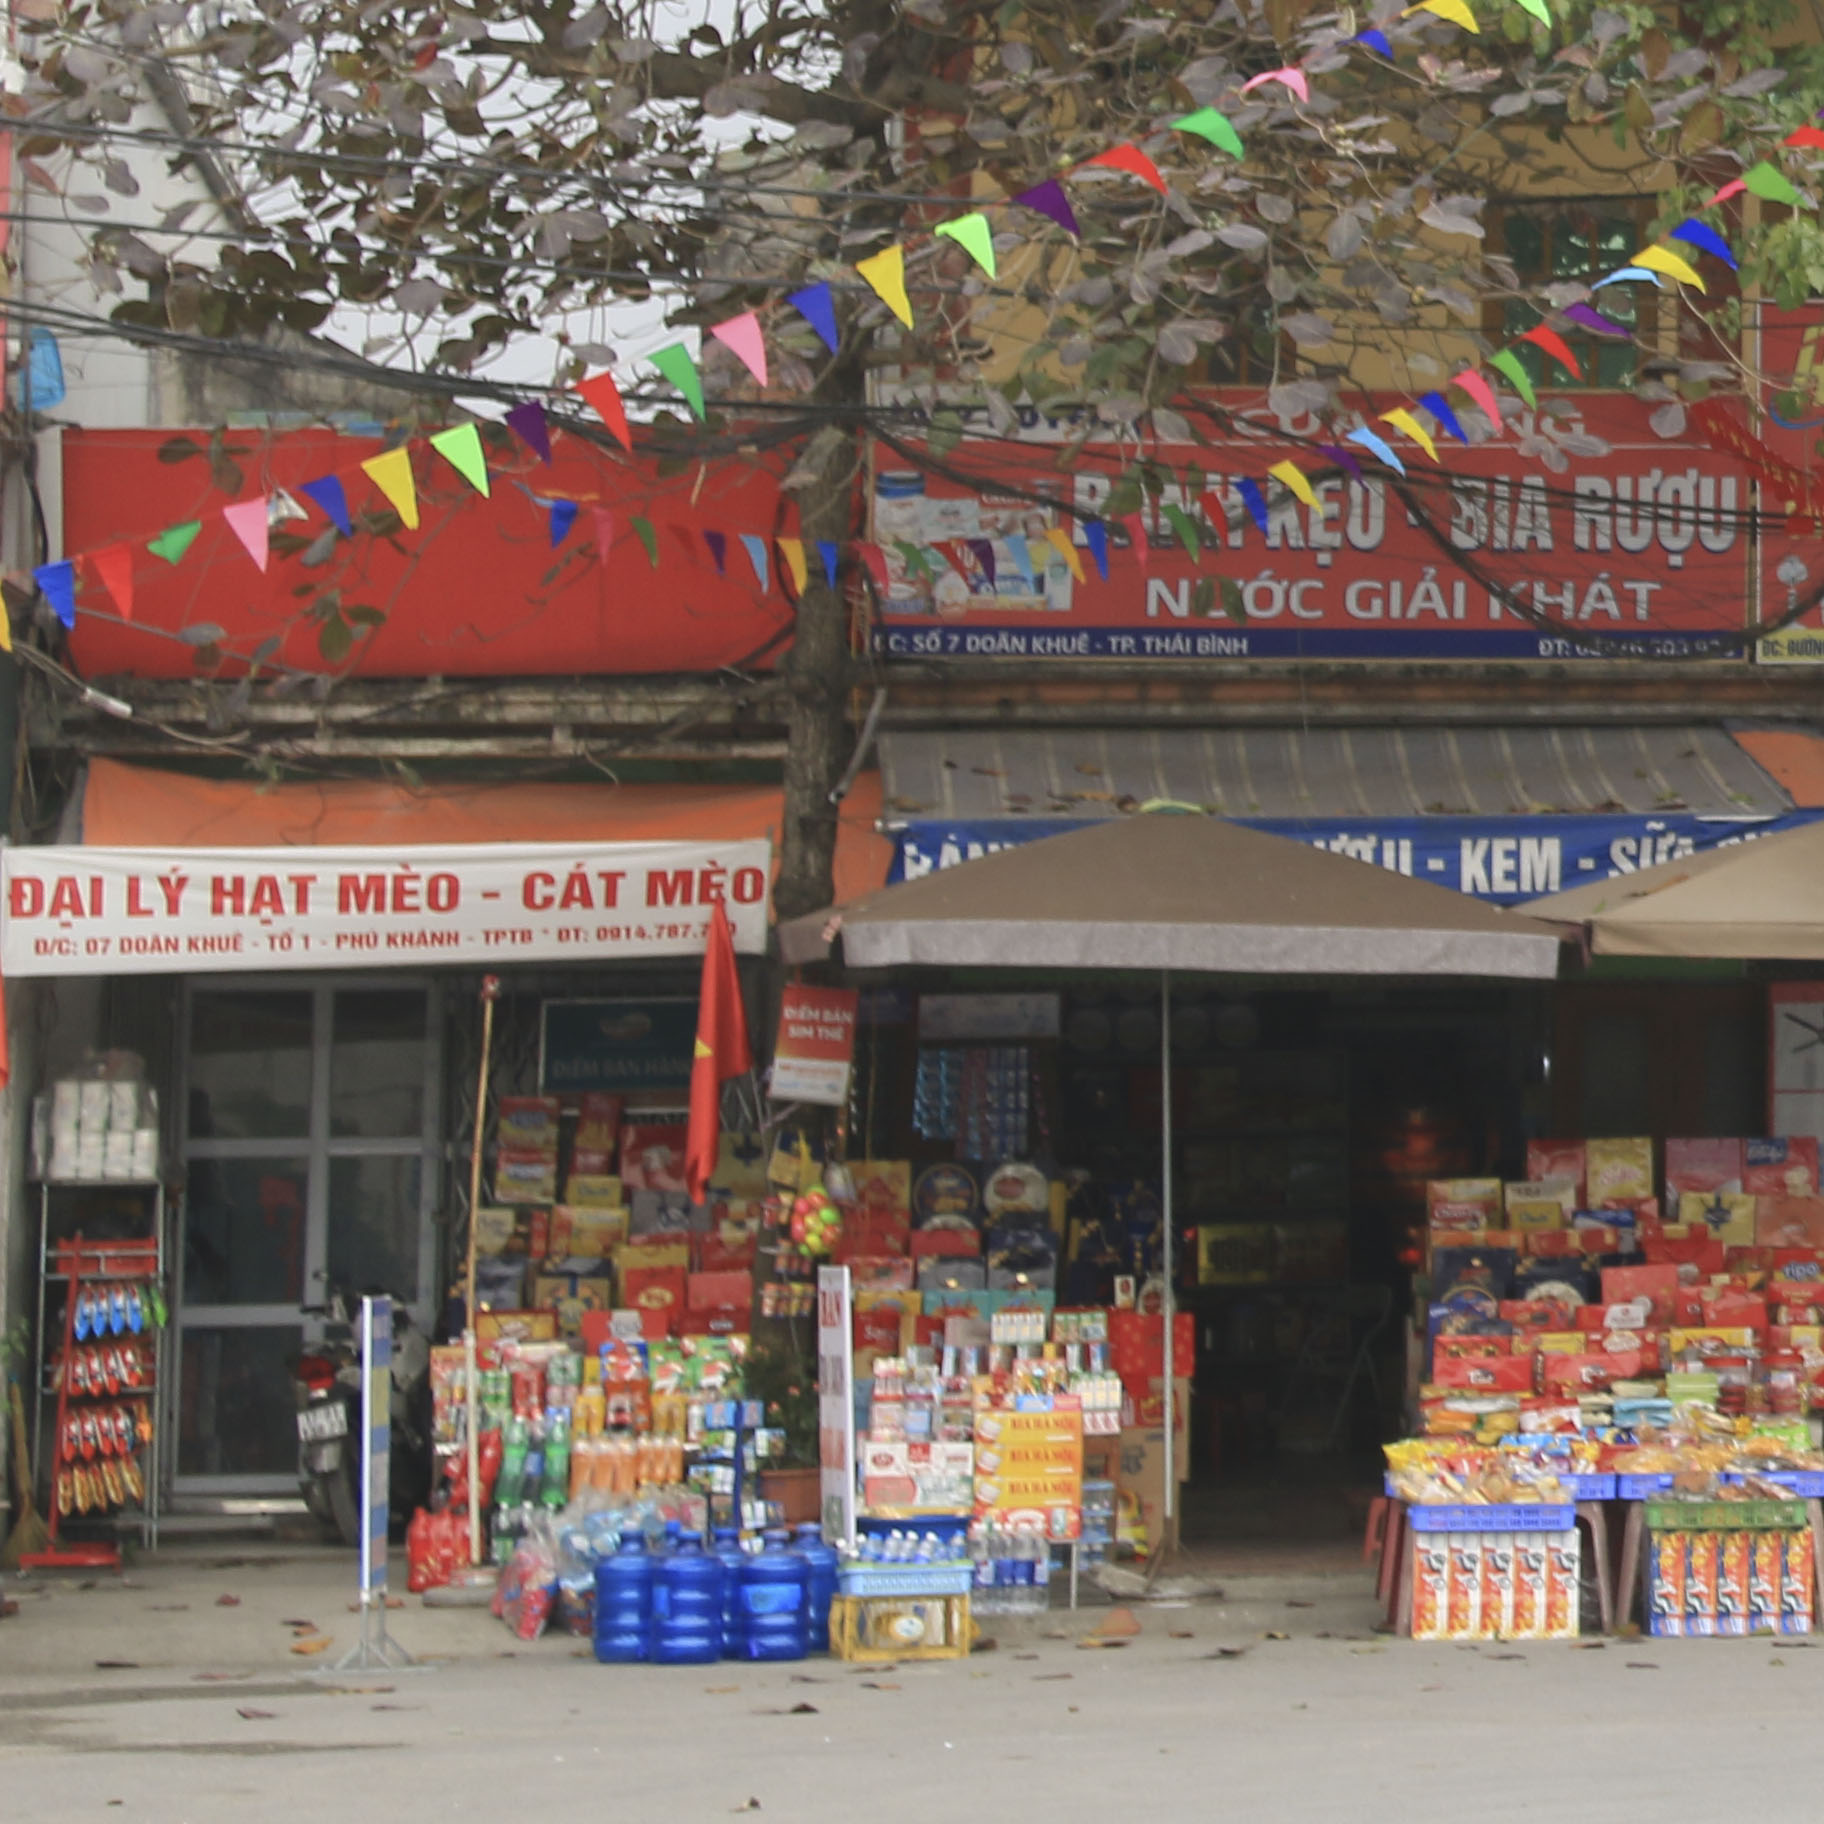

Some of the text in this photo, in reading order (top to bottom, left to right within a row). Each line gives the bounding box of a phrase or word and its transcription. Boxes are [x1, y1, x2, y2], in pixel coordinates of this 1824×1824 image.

[1572, 466, 1738, 569] RƯỢU
[1344, 566, 1467, 621] GIẢI
[947, 635, 960, 653] 7
[1030, 631, 1090, 656] KHUÊ
[1144, 629, 1193, 656] THÁI
[1197, 629, 1250, 657] BÌNH
[1460, 837, 1561, 894] KEM
[9, 859, 766, 929] ĐẠI LÝ HẠT MÈO CÁT MÈO
[85, 938, 111, 955] 07
[386, 926, 460, 948] KHÁNH
[483, 928, 533, 945] TPTB
[557, 925, 590, 943] ĐT:
